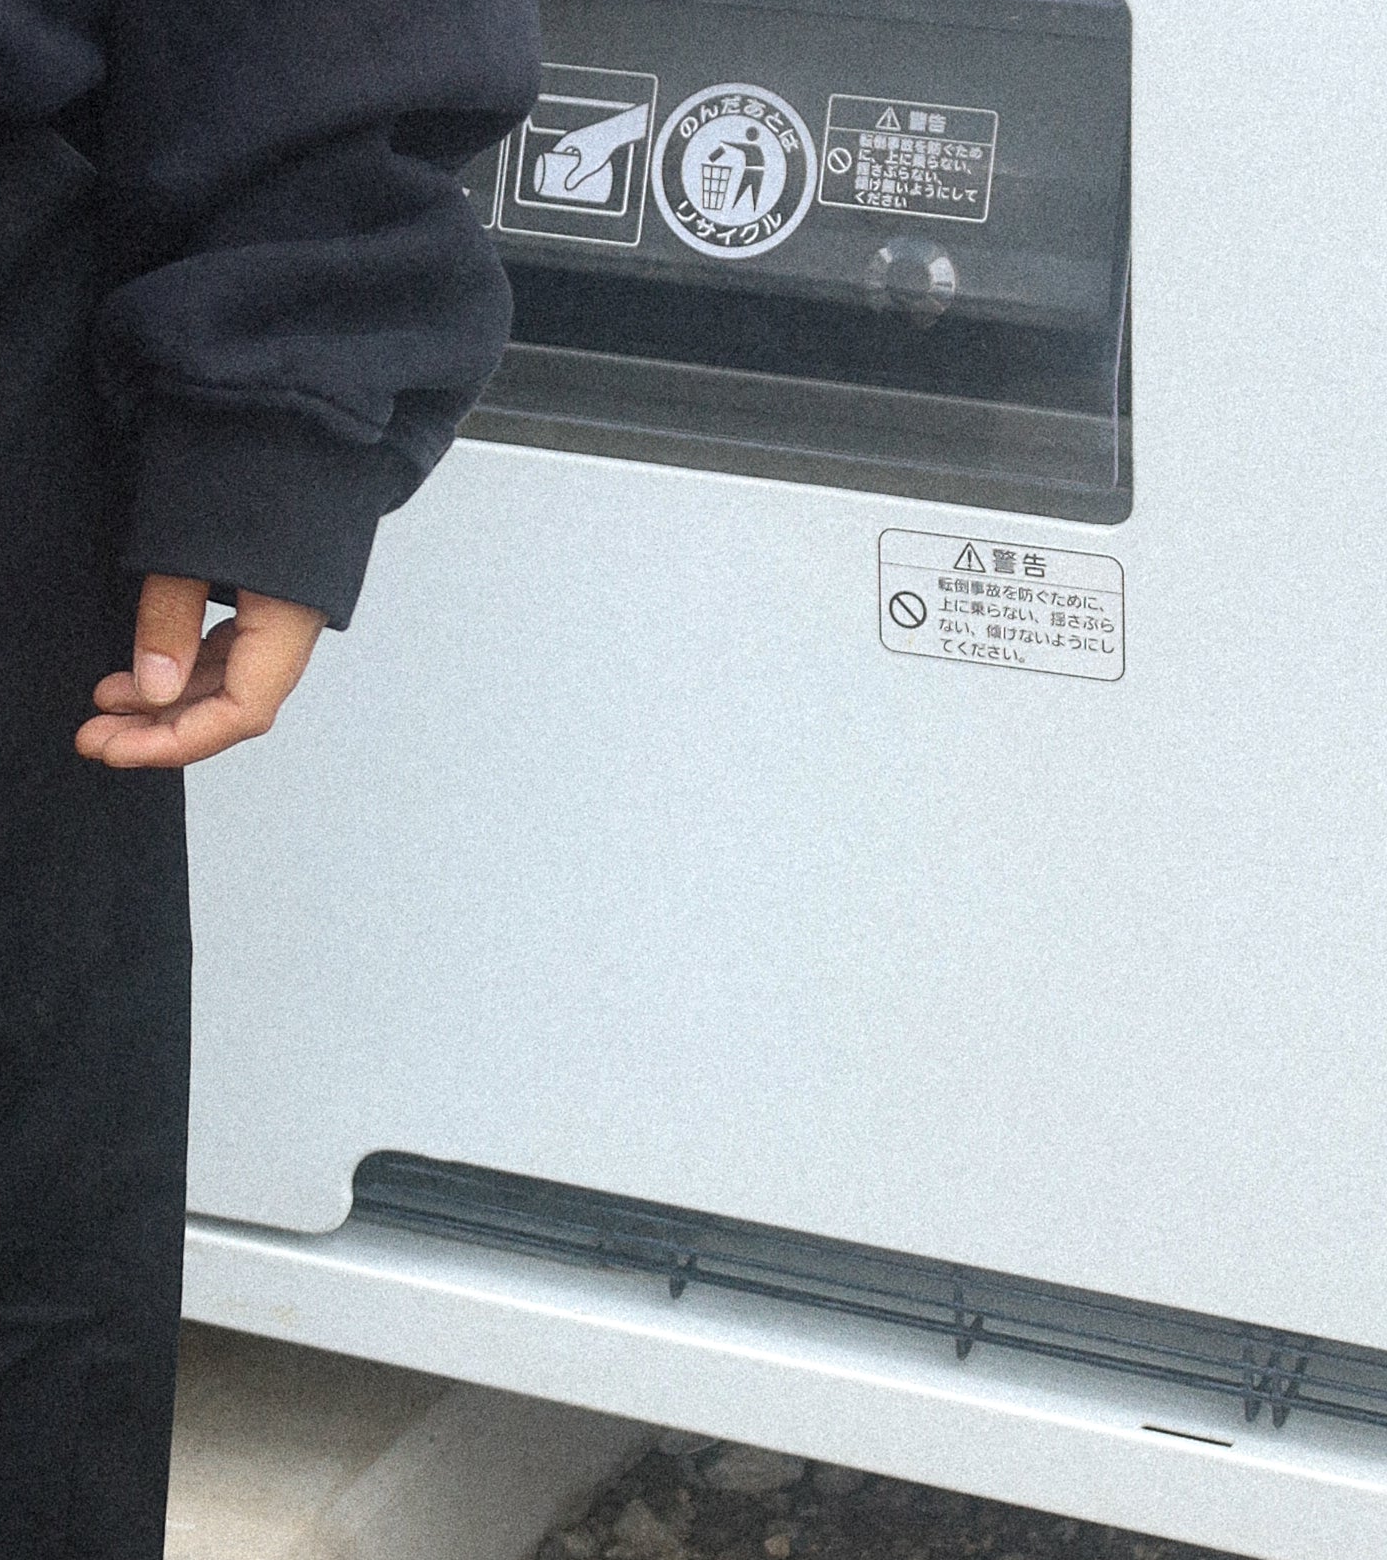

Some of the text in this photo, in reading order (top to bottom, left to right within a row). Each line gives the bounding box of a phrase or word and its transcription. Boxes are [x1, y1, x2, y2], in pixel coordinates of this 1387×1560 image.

[678, 94, 800, 154] のんだあとは
[907, 110, 947, 134] 警告
[854, 191, 908, 210] ください
[675, 199, 783, 245] リサイクル
[991, 547, 1047, 579] 警告
[937, 577, 1108, 613] 転倒事故を防ぐために、
[937, 597, 1116, 635] 上に乗らない、揺さぶら
[937, 617, 1116, 655] ない、傾けないようにし
[940, 638, 1027, 666] てください。
